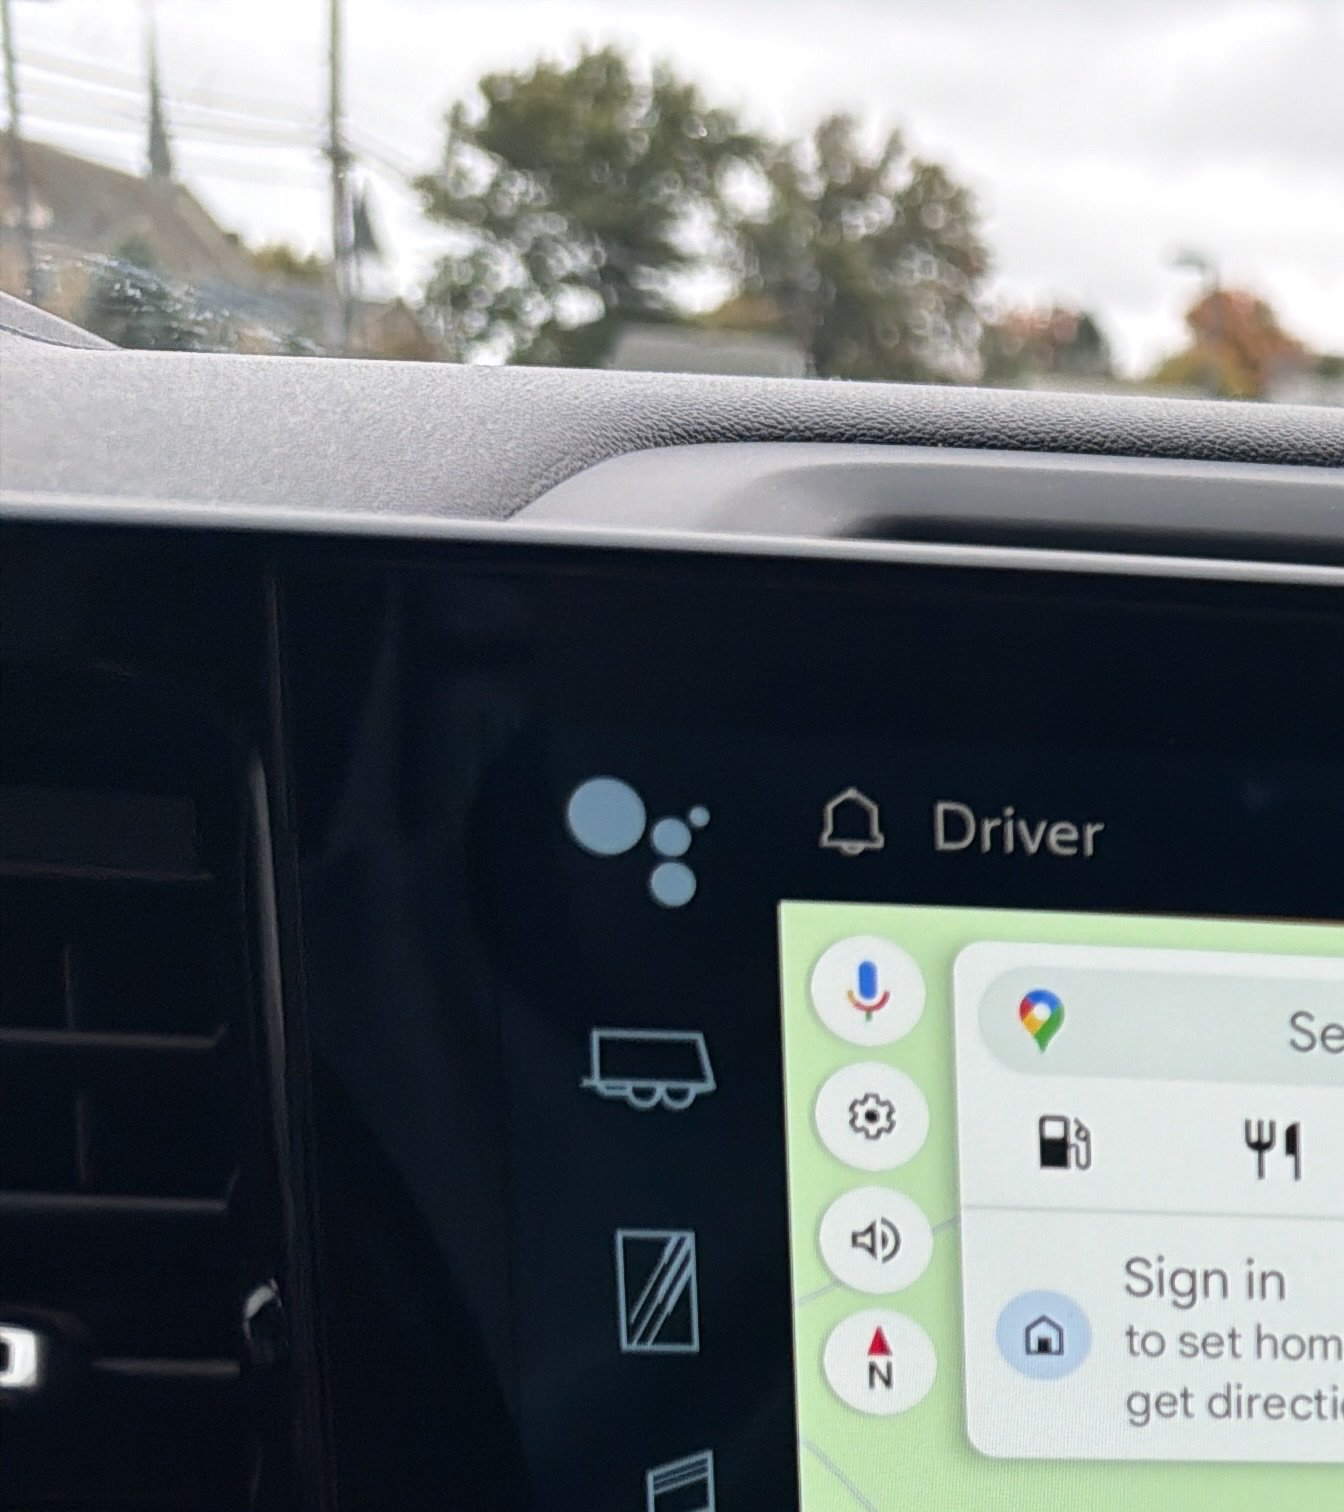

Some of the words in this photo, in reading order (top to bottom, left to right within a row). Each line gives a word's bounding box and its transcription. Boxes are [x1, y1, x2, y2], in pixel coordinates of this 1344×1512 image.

[934, 802, 1104, 858] Driver
[1124, 1256, 1229, 1312] Sign
[1246, 1260, 1286, 1300] in
[1126, 1326, 1166, 1360] to
[1178, 1327, 1242, 1362] set
[868, 1363, 893, 1391] N
[1126, 1388, 1194, 1428] get
